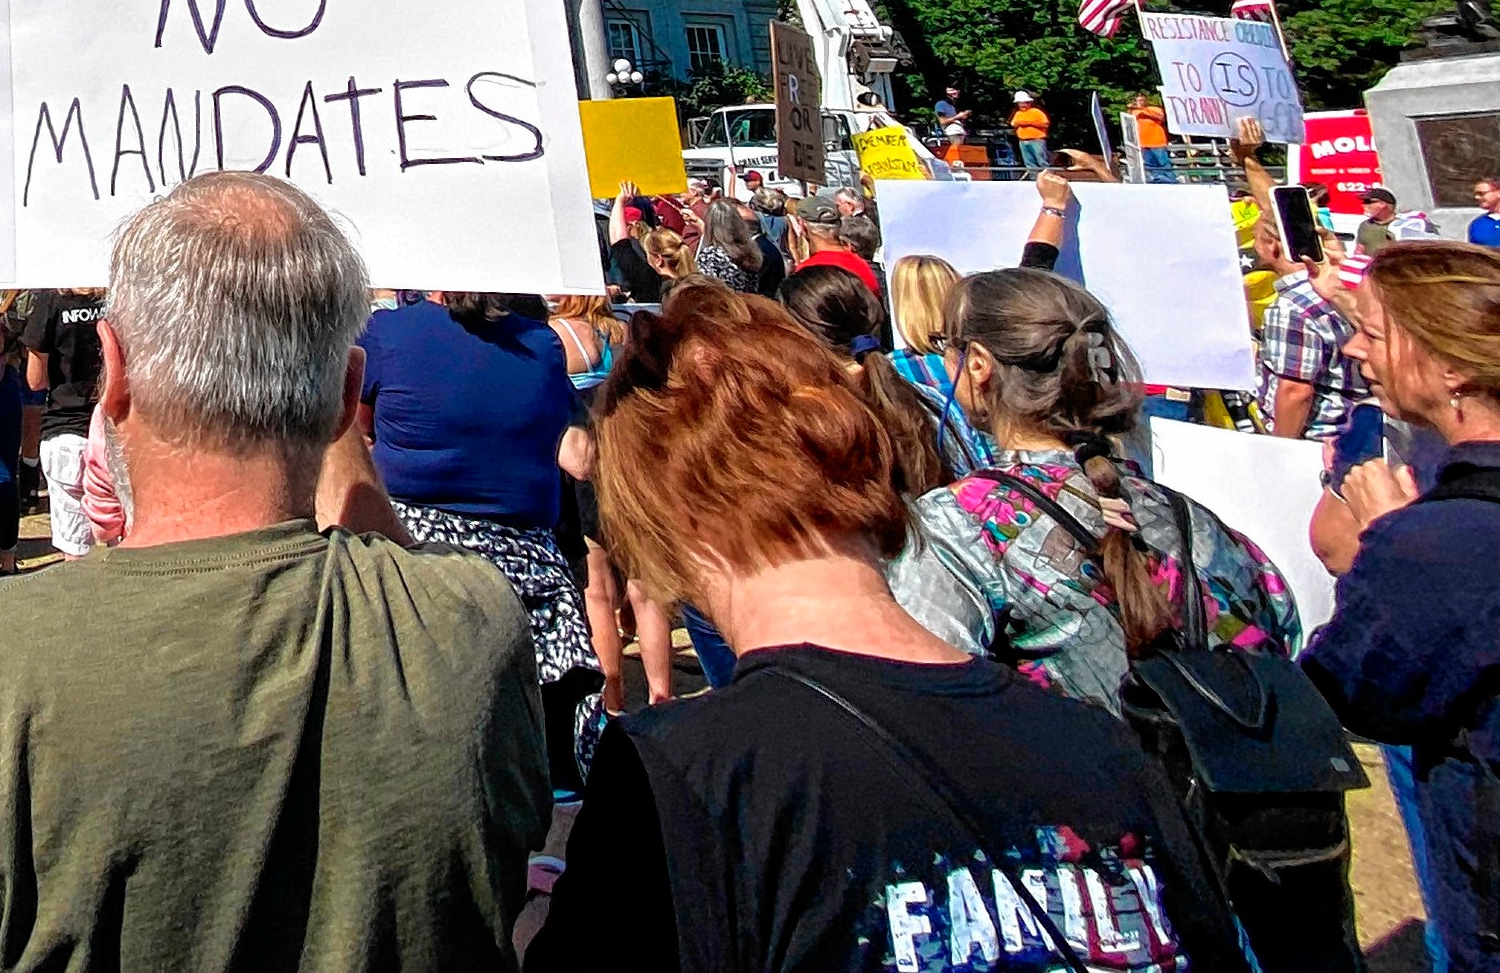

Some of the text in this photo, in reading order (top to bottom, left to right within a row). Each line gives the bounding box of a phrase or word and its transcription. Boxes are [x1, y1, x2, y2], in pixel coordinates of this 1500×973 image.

[1147, 17, 1230, 42] RESISTANCE
[1172, 61, 1291, 99] TO IS TO
[789, 107, 813, 133] OR
[1167, 96, 1230, 128] TYRANNY
[22, 71, 544, 207] MANDATES
[791, 140, 816, 171] DIE
